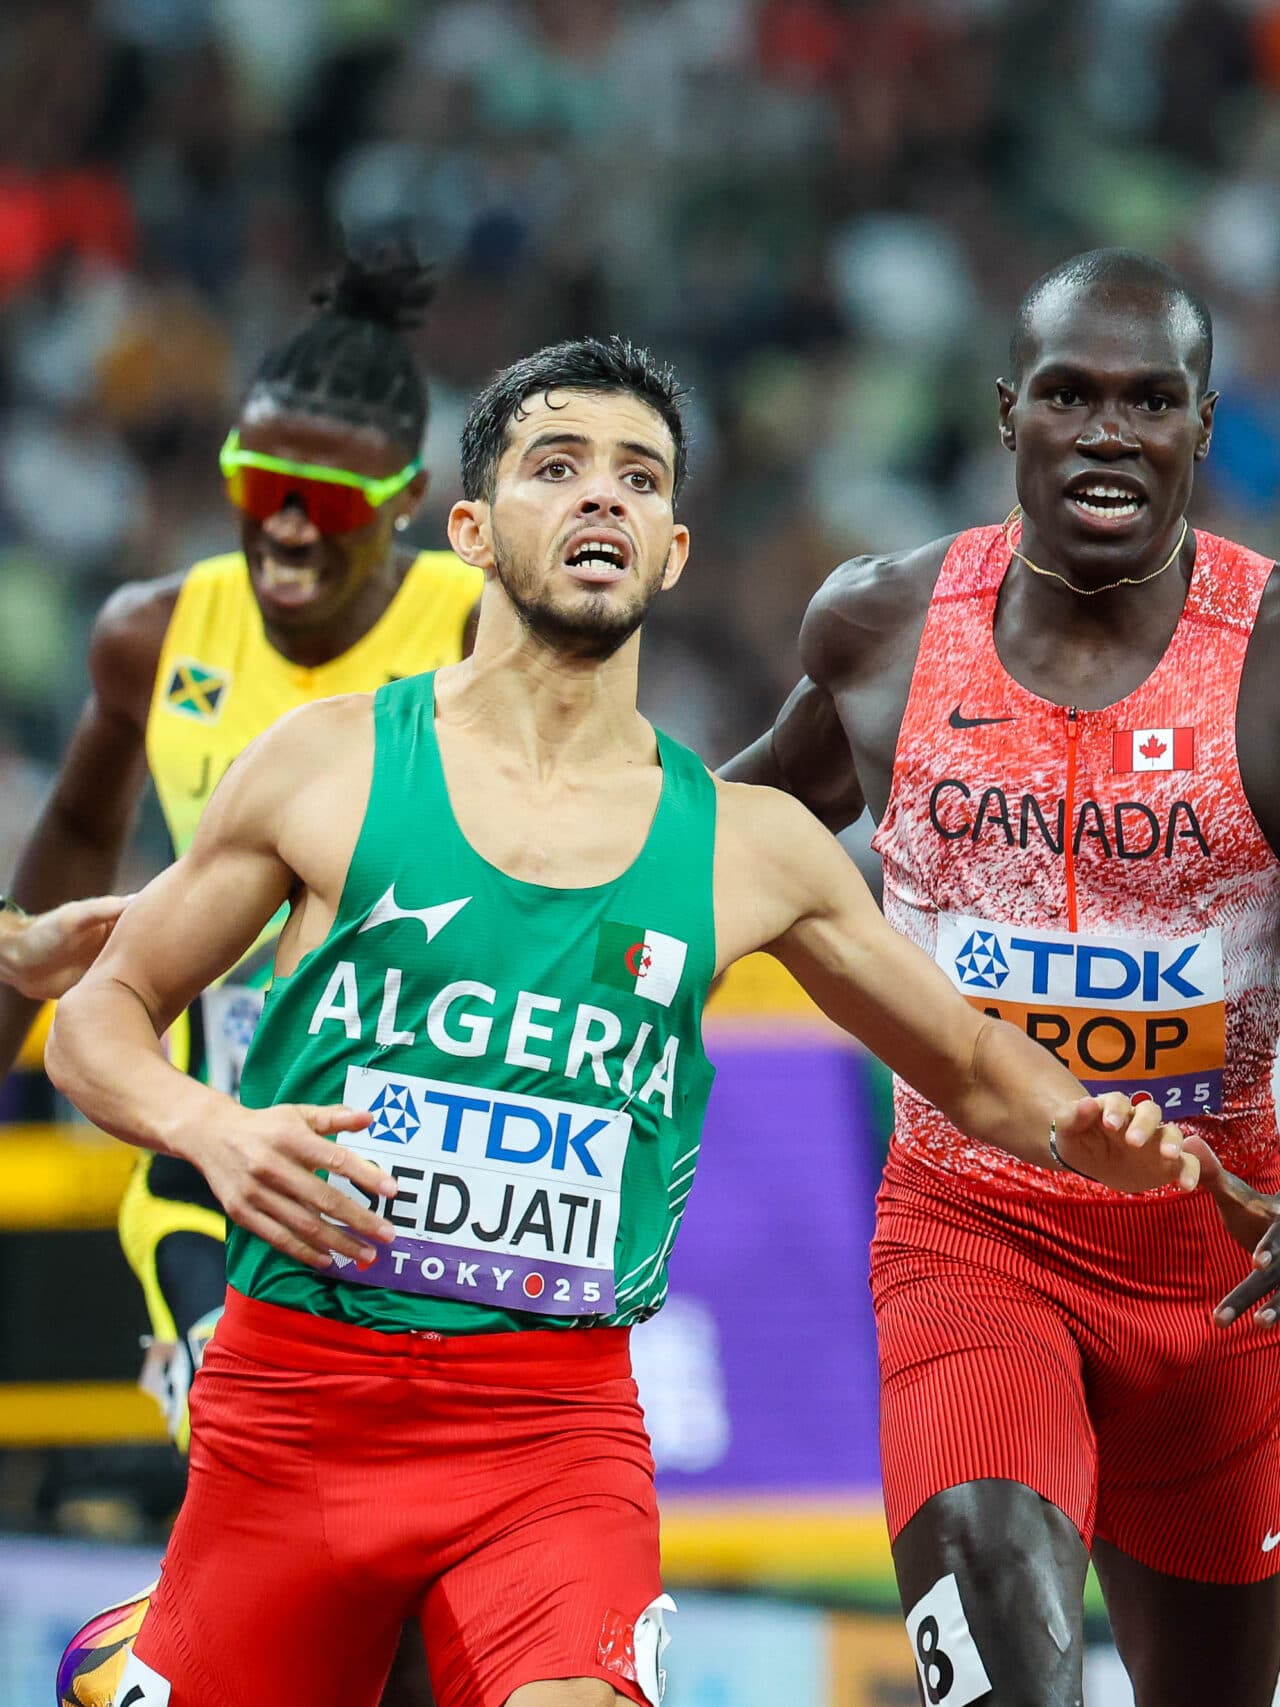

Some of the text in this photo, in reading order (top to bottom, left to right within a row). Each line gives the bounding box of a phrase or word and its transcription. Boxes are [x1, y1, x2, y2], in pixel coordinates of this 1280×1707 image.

[929, 780, 1210, 859] CANADA
[1010, 937, 1205, 1001] TDK
[308, 961, 681, 1118] ALGERIA
[984, 1008, 1188, 1072] ROP
[424, 1090, 611, 1178] TDK
[917, 1615, 954, 1706] 8
